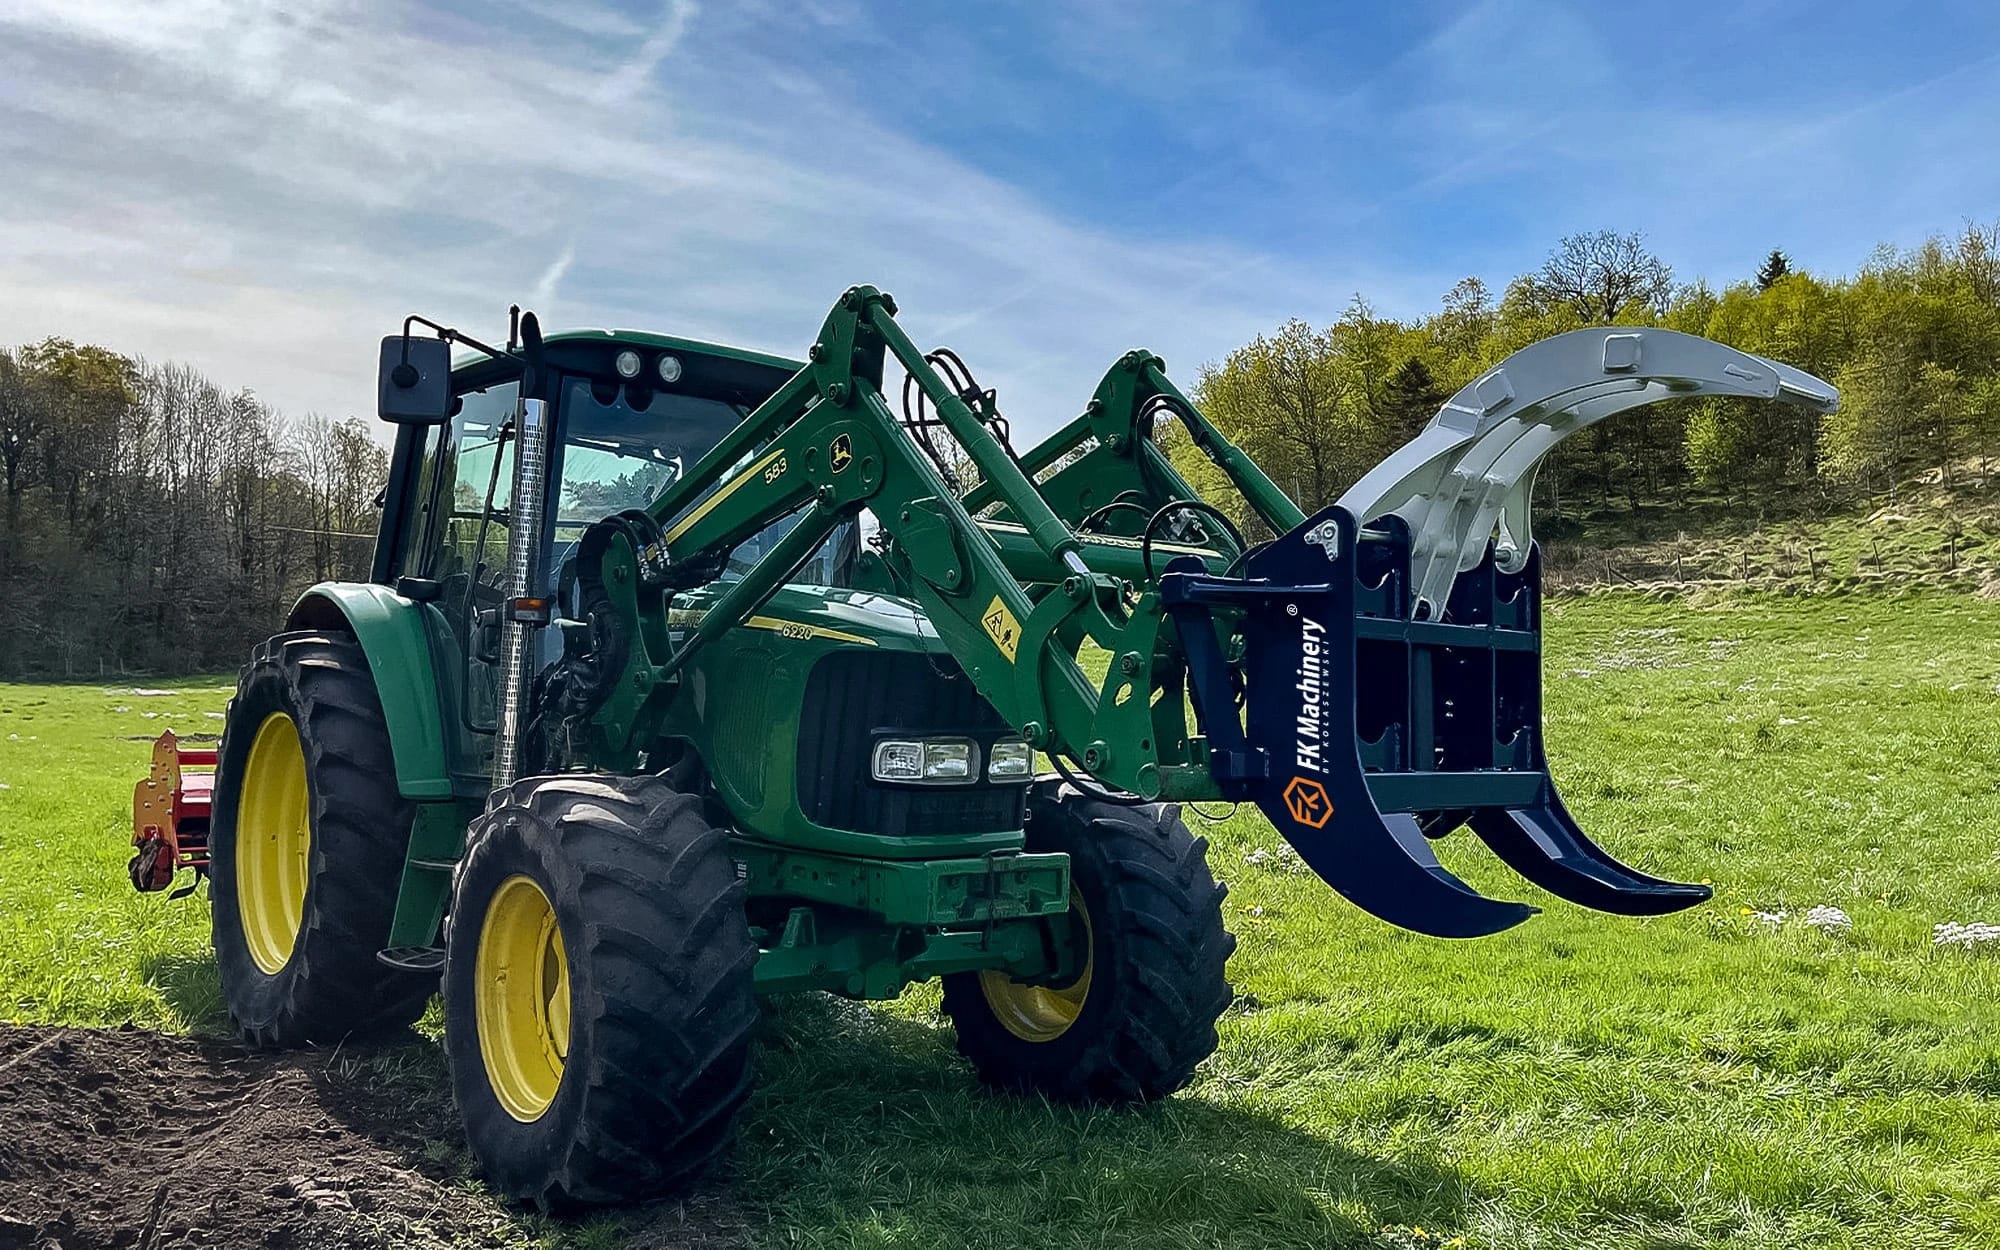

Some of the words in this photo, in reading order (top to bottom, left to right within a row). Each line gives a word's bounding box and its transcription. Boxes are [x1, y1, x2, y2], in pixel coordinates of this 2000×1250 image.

[765, 457, 787, 484] 583
[782, 623, 813, 640] 6220
[1296, 616, 1327, 739] Machinery
[1296, 740, 1321, 771] FK
[1323, 758, 1330, 774] BY
